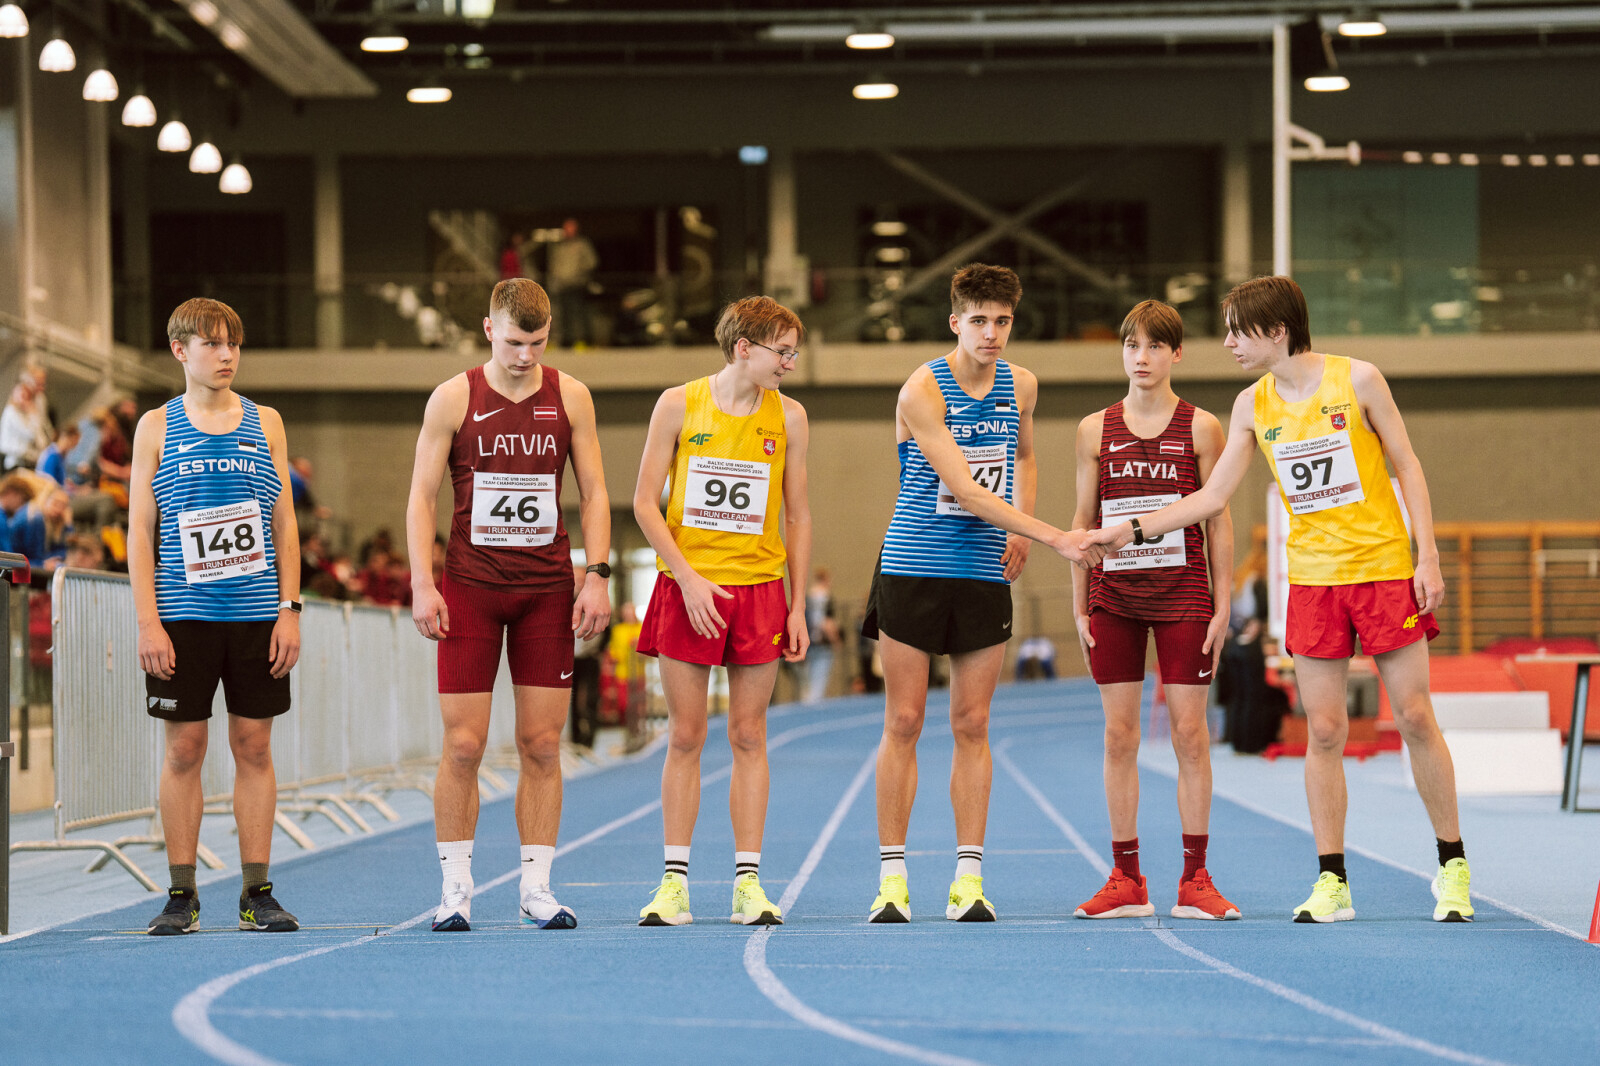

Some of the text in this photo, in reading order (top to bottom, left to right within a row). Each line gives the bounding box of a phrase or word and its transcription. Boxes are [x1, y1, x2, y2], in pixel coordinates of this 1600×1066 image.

[950, 420, 1009, 438] ESONIA
[478, 434, 557, 456] LATVIA
[688, 433, 714, 446] 4F
[1290, 444, 1328, 454] CHAMPIONSHIPS
[178, 458, 257, 476] ESTONIA
[712, 465, 751, 474] CHAMPIONSHIPS
[1109, 461, 1178, 480] LATVIA
[1291, 456, 1333, 490] 97
[704, 479, 750, 510] 96
[202, 511, 242, 521] CHAMPIONSHIPS
[490, 496, 540, 523] 46
[190, 523, 256, 558] 148
[206, 560, 223, 569] RUN
[200, 571, 224, 579] VALMIERA
[1403, 614, 1418, 628] 4F
